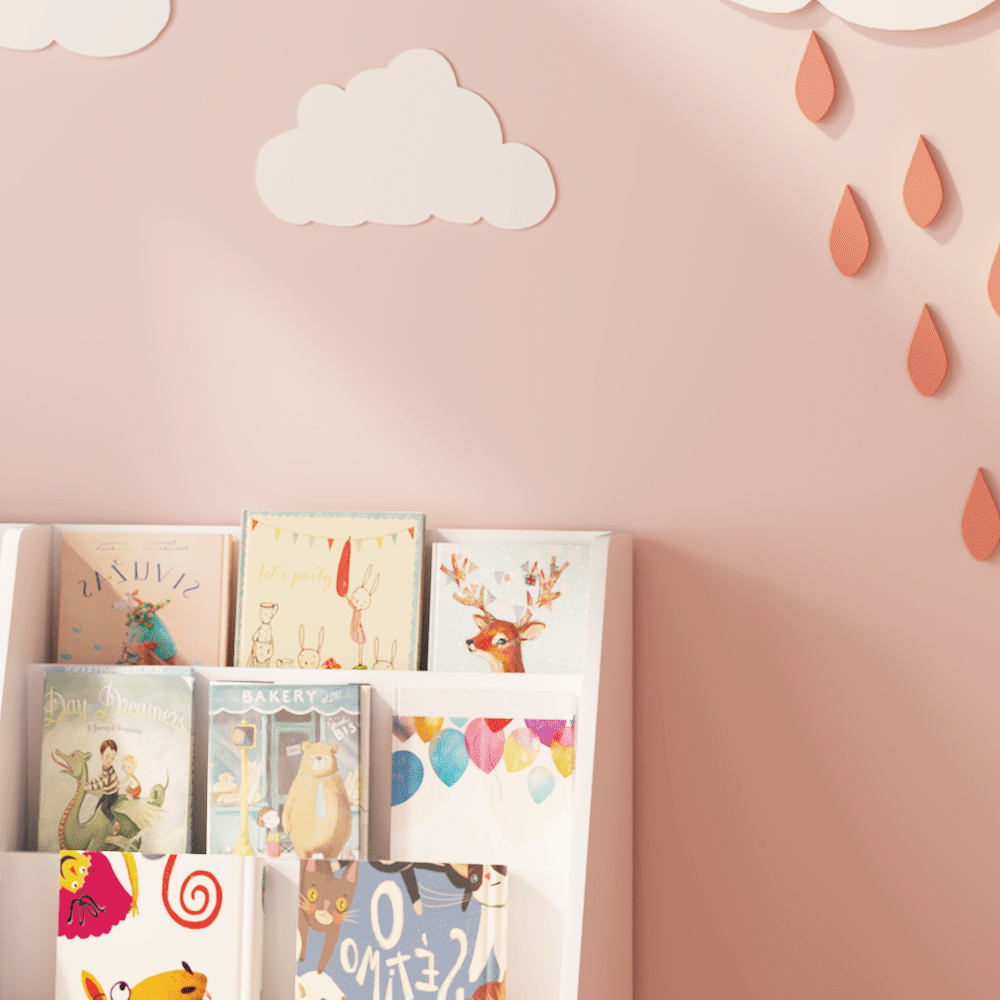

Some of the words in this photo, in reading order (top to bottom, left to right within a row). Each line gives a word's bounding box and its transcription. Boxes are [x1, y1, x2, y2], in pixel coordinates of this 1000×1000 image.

[291, 566, 331, 592] party
[43, 687, 87, 727] Day
[95, 681, 187, 733] Dreamers
[242, 689, 317, 704] BAKERY
